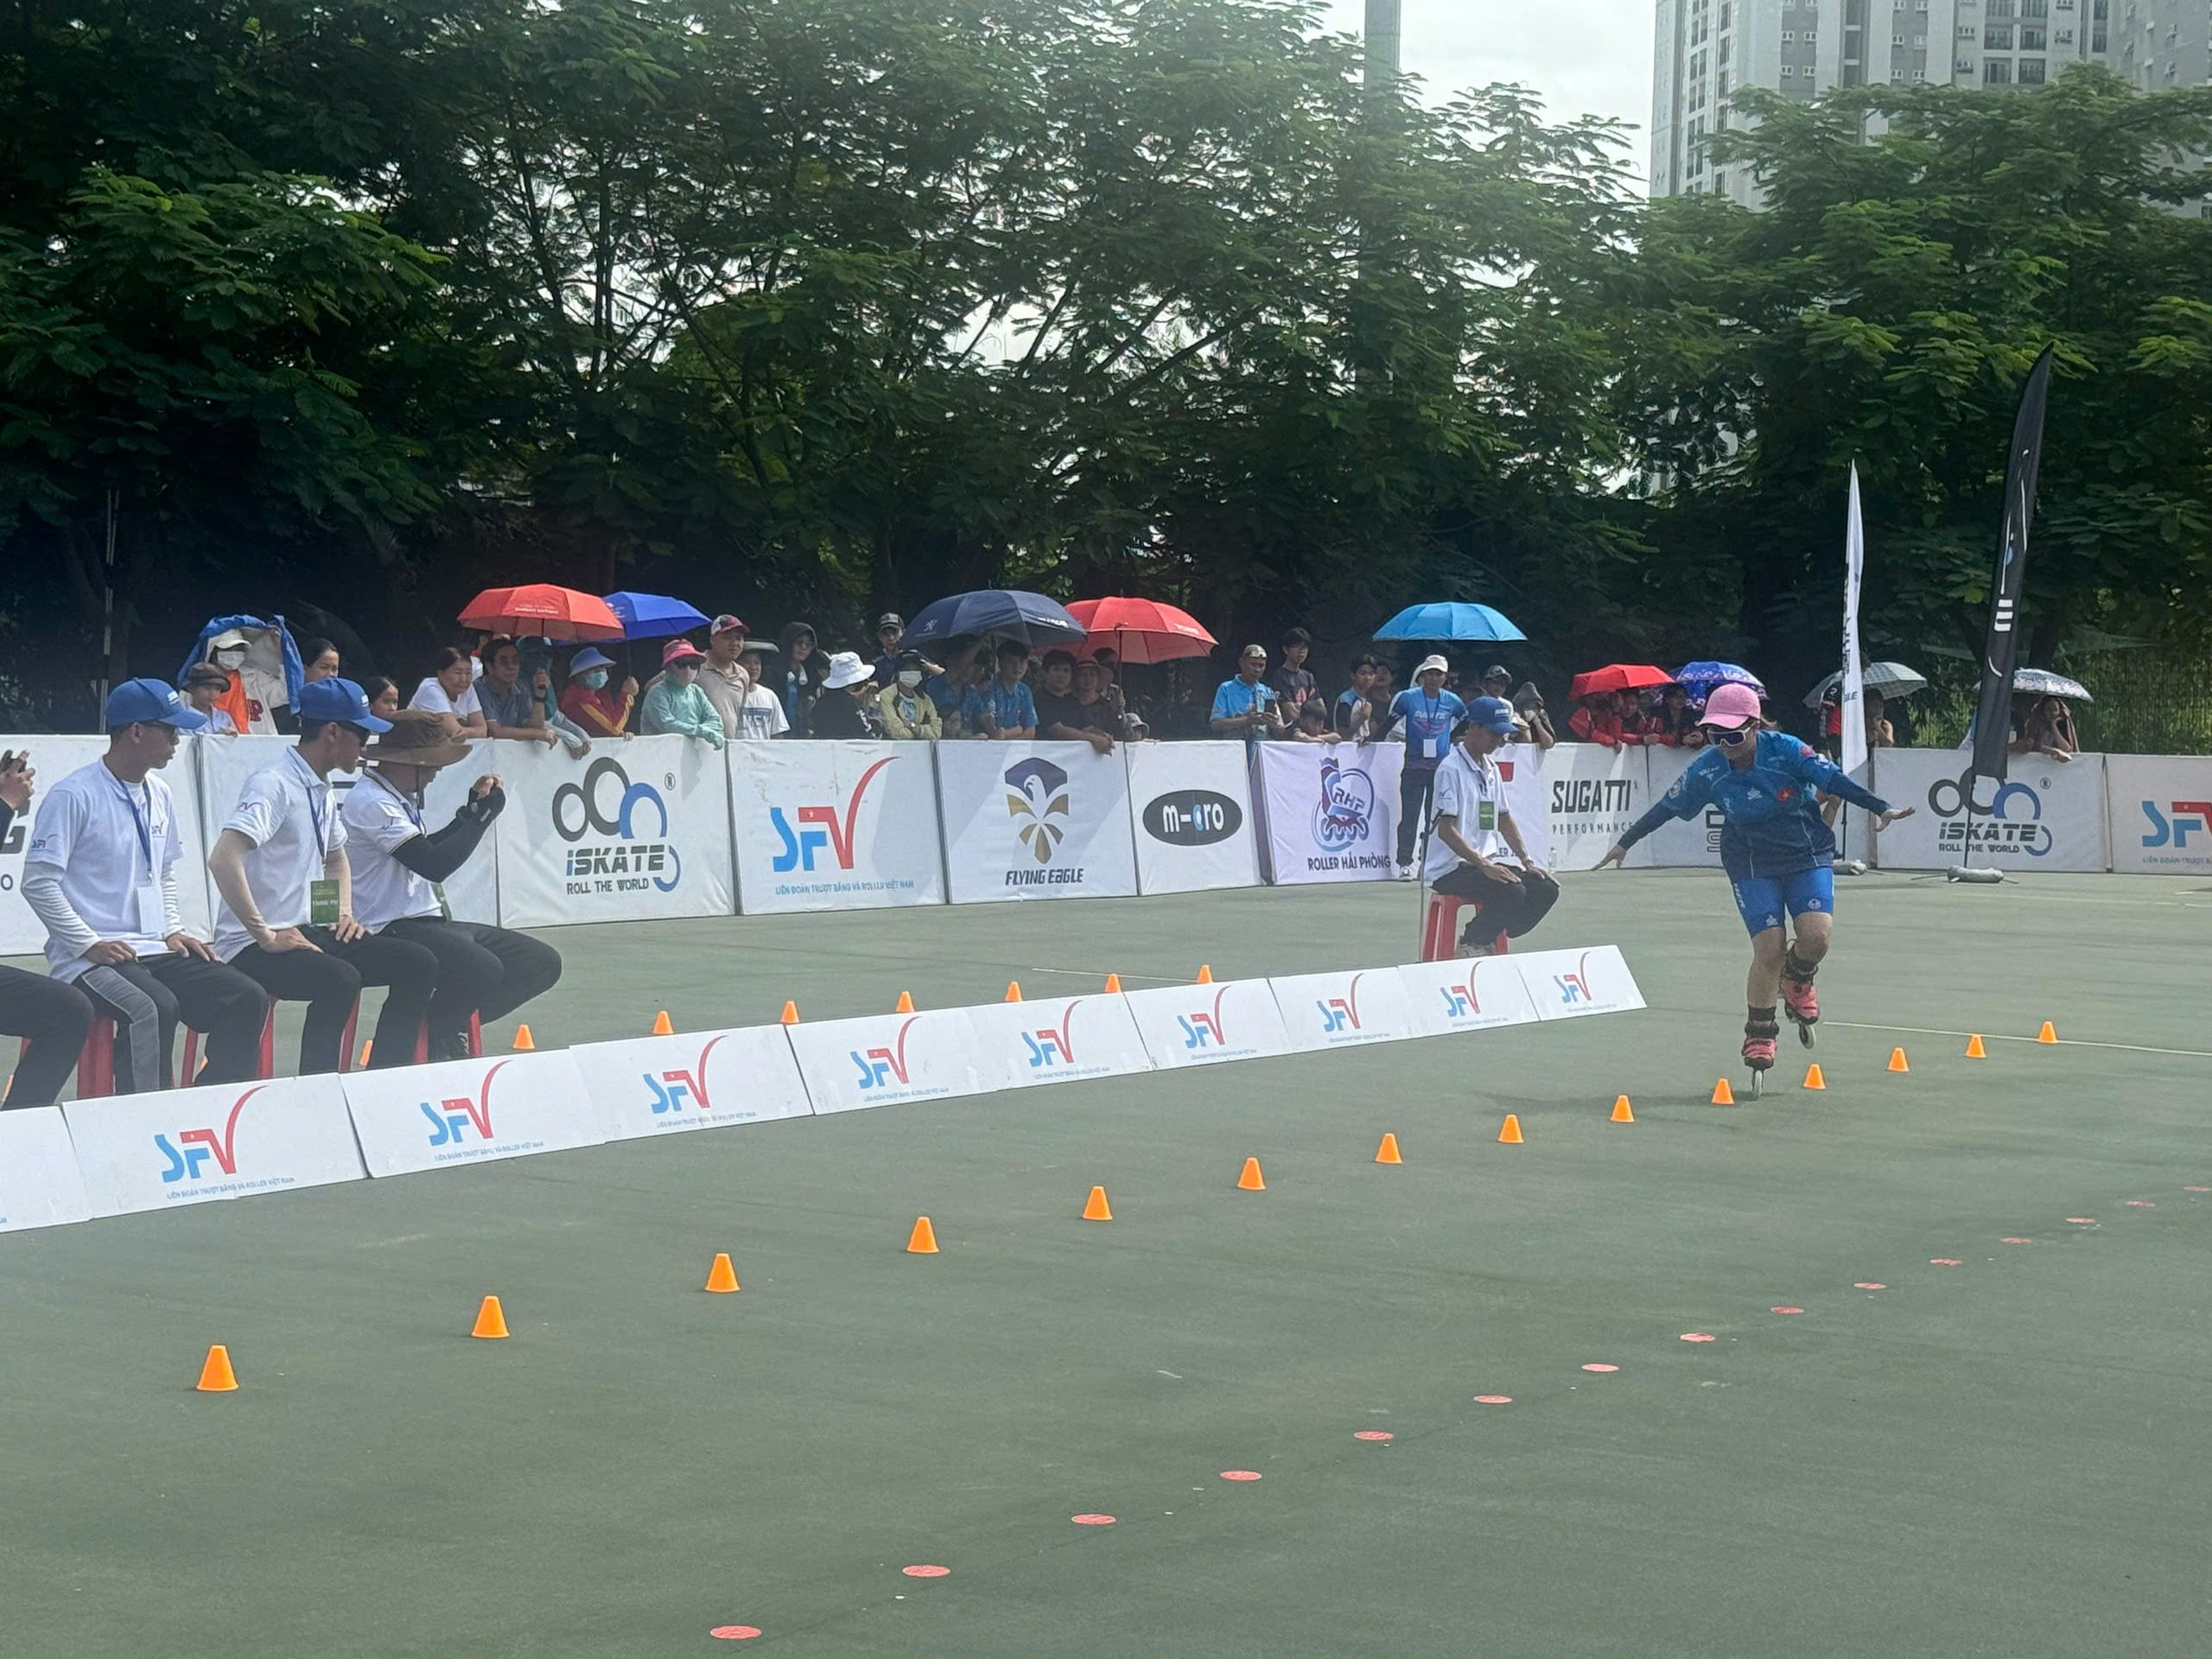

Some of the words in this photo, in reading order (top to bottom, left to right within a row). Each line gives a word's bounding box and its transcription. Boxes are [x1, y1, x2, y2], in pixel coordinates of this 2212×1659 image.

[770, 756, 902, 872] SFV
[1551, 779, 1631, 813] SUGATTI
[566, 844, 664, 876] iSKATE
[1939, 822, 2037, 842] iSKATE
[1939, 843, 1962, 852] ROLL
[1987, 845, 2020, 854] WORLD
[567, 881, 591, 895] ROLL
[594, 879, 613, 893] THE
[617, 878, 649, 892] WORLD
[1005, 869, 1046, 886] FLYING
[1307, 856, 1339, 871] ROLLER
[1360, 852, 1391, 868] PHÒNG
[1317, 973, 1364, 1033] SFV
[1440, 960, 1483, 1018] SFV
[1553, 951, 1591, 1004] SFV
[1021, 999, 1084, 1068] SFV
[1177, 985, 1231, 1049] SFV
[643, 1034, 729, 1114] SFV
[850, 1016, 923, 1090] SFV
[419, 1059, 513, 1147] SFV
[154, 1085, 269, 1183] SFV
